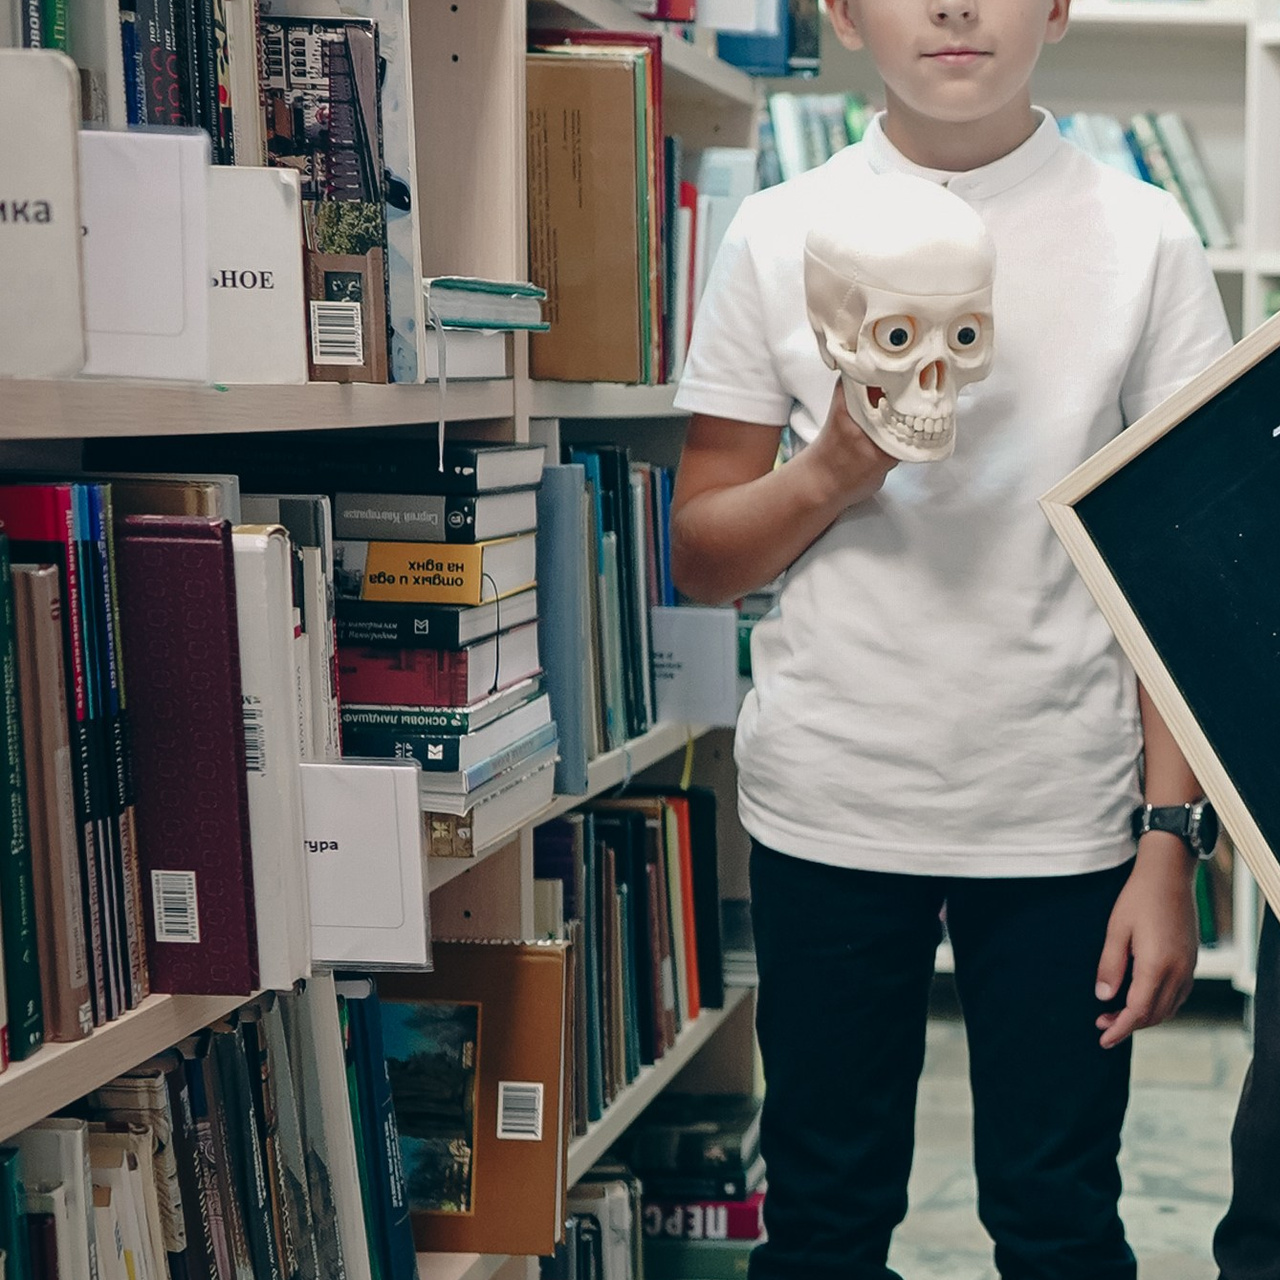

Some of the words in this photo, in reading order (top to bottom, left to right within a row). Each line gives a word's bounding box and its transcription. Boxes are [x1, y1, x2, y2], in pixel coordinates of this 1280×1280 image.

[407, 558, 442, 572] вднх
[446, 561, 464, 572] на
[367, 570, 394, 585] еда
[398, 574, 407, 585] и
[411, 572, 463, 587] отдых
[399, 713, 447, 725] ОСНОВЫ
